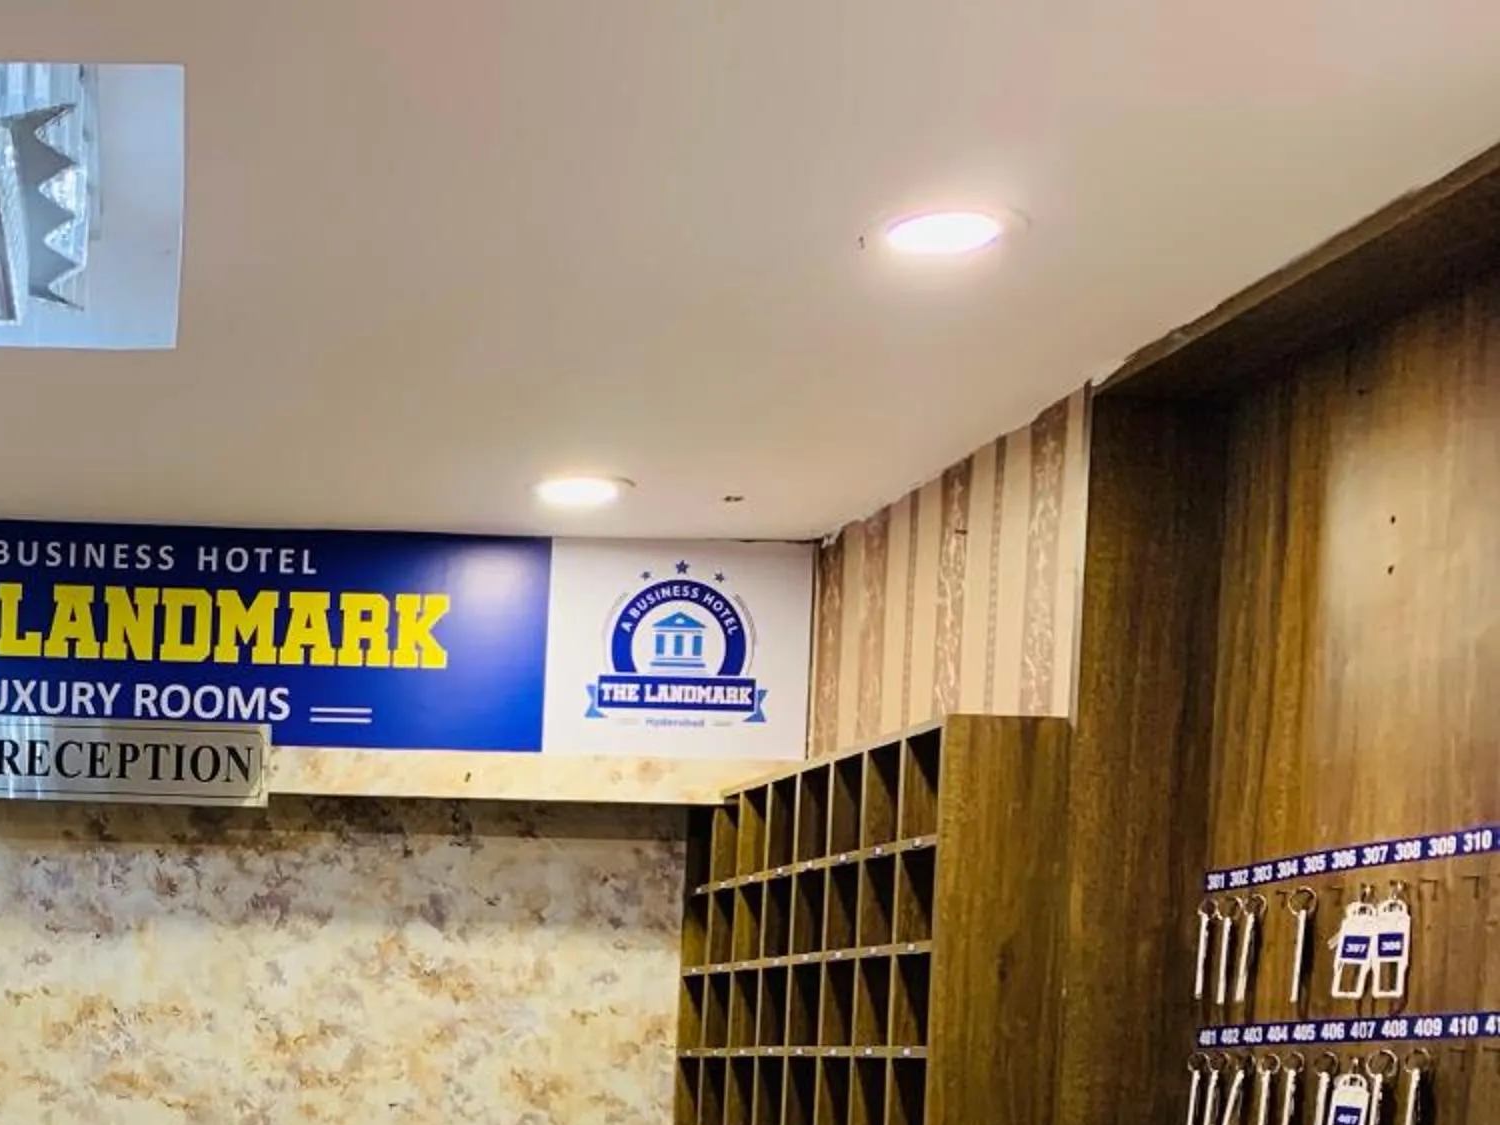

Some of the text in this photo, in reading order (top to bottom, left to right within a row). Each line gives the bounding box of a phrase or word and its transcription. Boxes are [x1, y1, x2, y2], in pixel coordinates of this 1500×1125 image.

[198, 547, 317, 574] HOTEL
[620, 585, 740, 636] A BUSINESS HOTEL
[133, 683, 291, 721] ROOMS
[601, 683, 752, 705] THE LANDMARK
[1252, 864, 1273, 883] 303
[1277, 859, 1298, 878] 304
[1303, 854, 1326, 874] 305
[1331, 849, 1357, 869] 306
[1362, 844, 1388, 865] 307
[1394, 840, 1421, 861] 308
[1427, 835, 1457, 857] 309
[1463, 829, 1492, 852] 310
[1243, 1025, 1263, 1043] 403
[1266, 1024, 1288, 1042] 404
[1292, 1023, 1316, 1041] 405
[1321, 1021, 1345, 1040] 406
[1350, 1020, 1376, 1039] 407
[1381, 1018, 1408, 1038] 408
[1413, 1017, 1443, 1037] 409
[1448, 1015, 1479, 1036] 410
